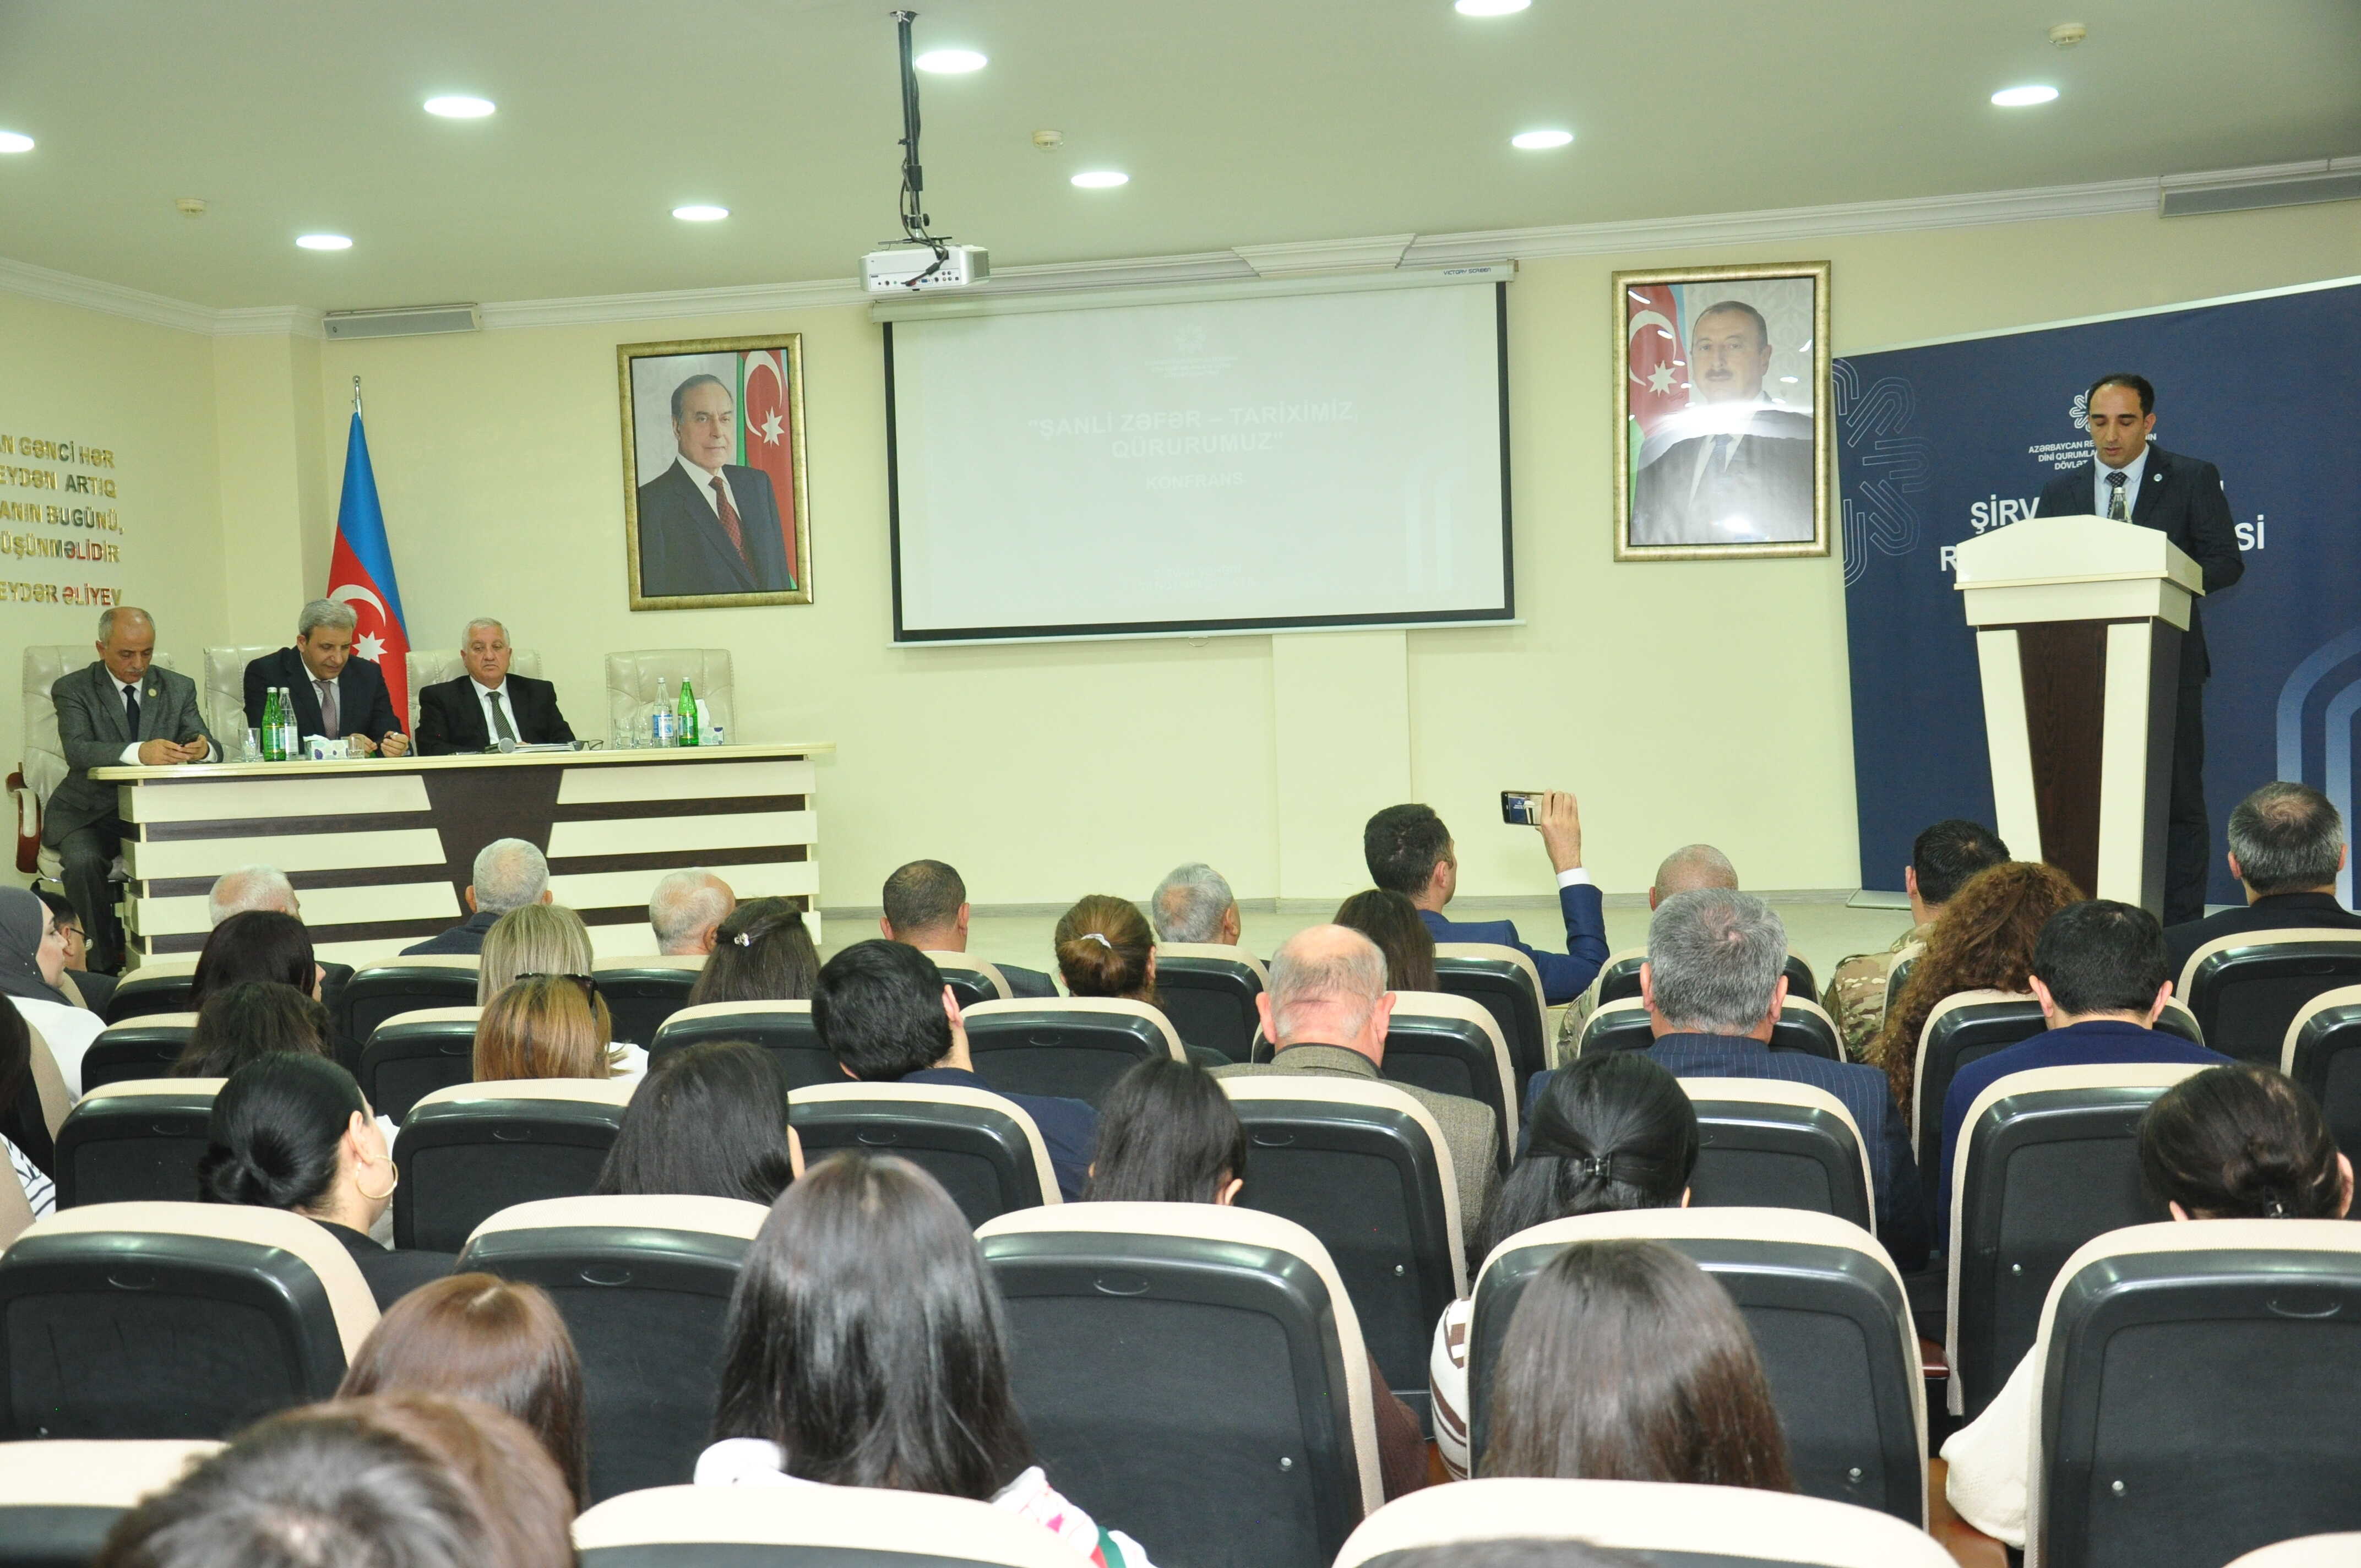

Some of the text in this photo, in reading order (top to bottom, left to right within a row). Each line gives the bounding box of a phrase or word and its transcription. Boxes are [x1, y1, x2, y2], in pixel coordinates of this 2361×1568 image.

[1119, 410, 1202, 432] ZƏFƏR
[18, 437, 75, 464] GƏNCİ
[79, 446, 115, 469] HƏR
[2028, 441, 2083, 454] AZƏRBAYCAN
[2038, 453, 2055, 462] DİNİ
[65, 473, 117, 499] ARTIQ
[1145, 471, 1244, 491] KONFRANS
[62, 582, 123, 607] ƏLİYEV
